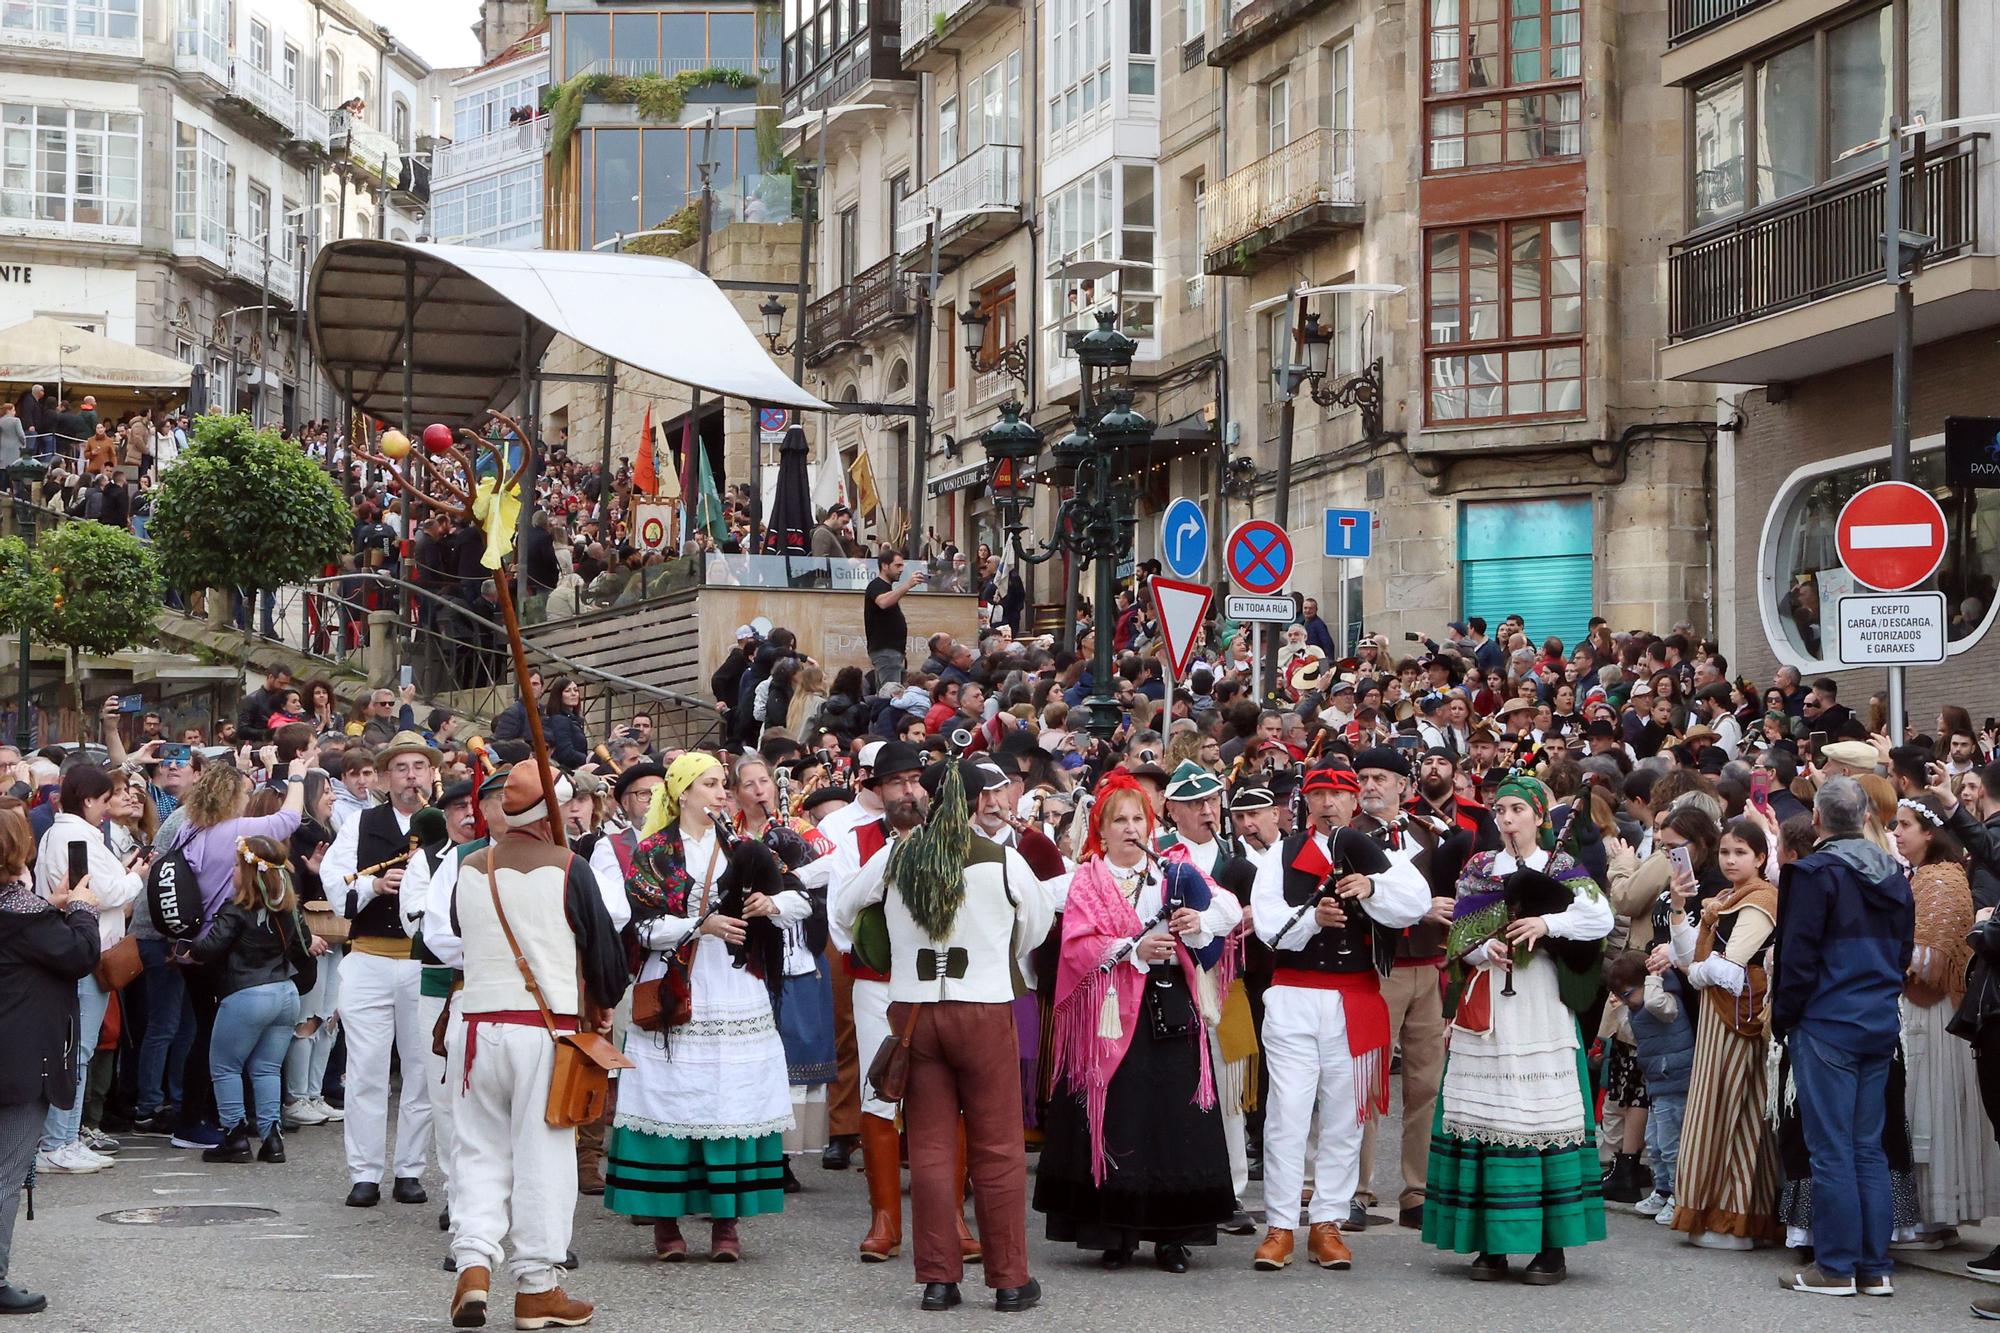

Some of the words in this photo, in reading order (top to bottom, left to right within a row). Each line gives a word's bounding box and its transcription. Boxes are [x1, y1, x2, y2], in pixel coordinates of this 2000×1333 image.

[0, 266, 31, 283] NTE
[1234, 603, 1244, 611] EN
[1246, 603, 1265, 612] TODA
[1265, 604, 1272, 613] A
[1272, 603, 1288, 613] RÚA
[1871, 605, 1910, 615] EXCEPTO
[1860, 630, 1921, 641] AUTORIZADOS
[1867, 645, 1873, 654] E
[1874, 643, 1915, 653] GARAXES
[158, 861, 189, 934] EVERLAST
